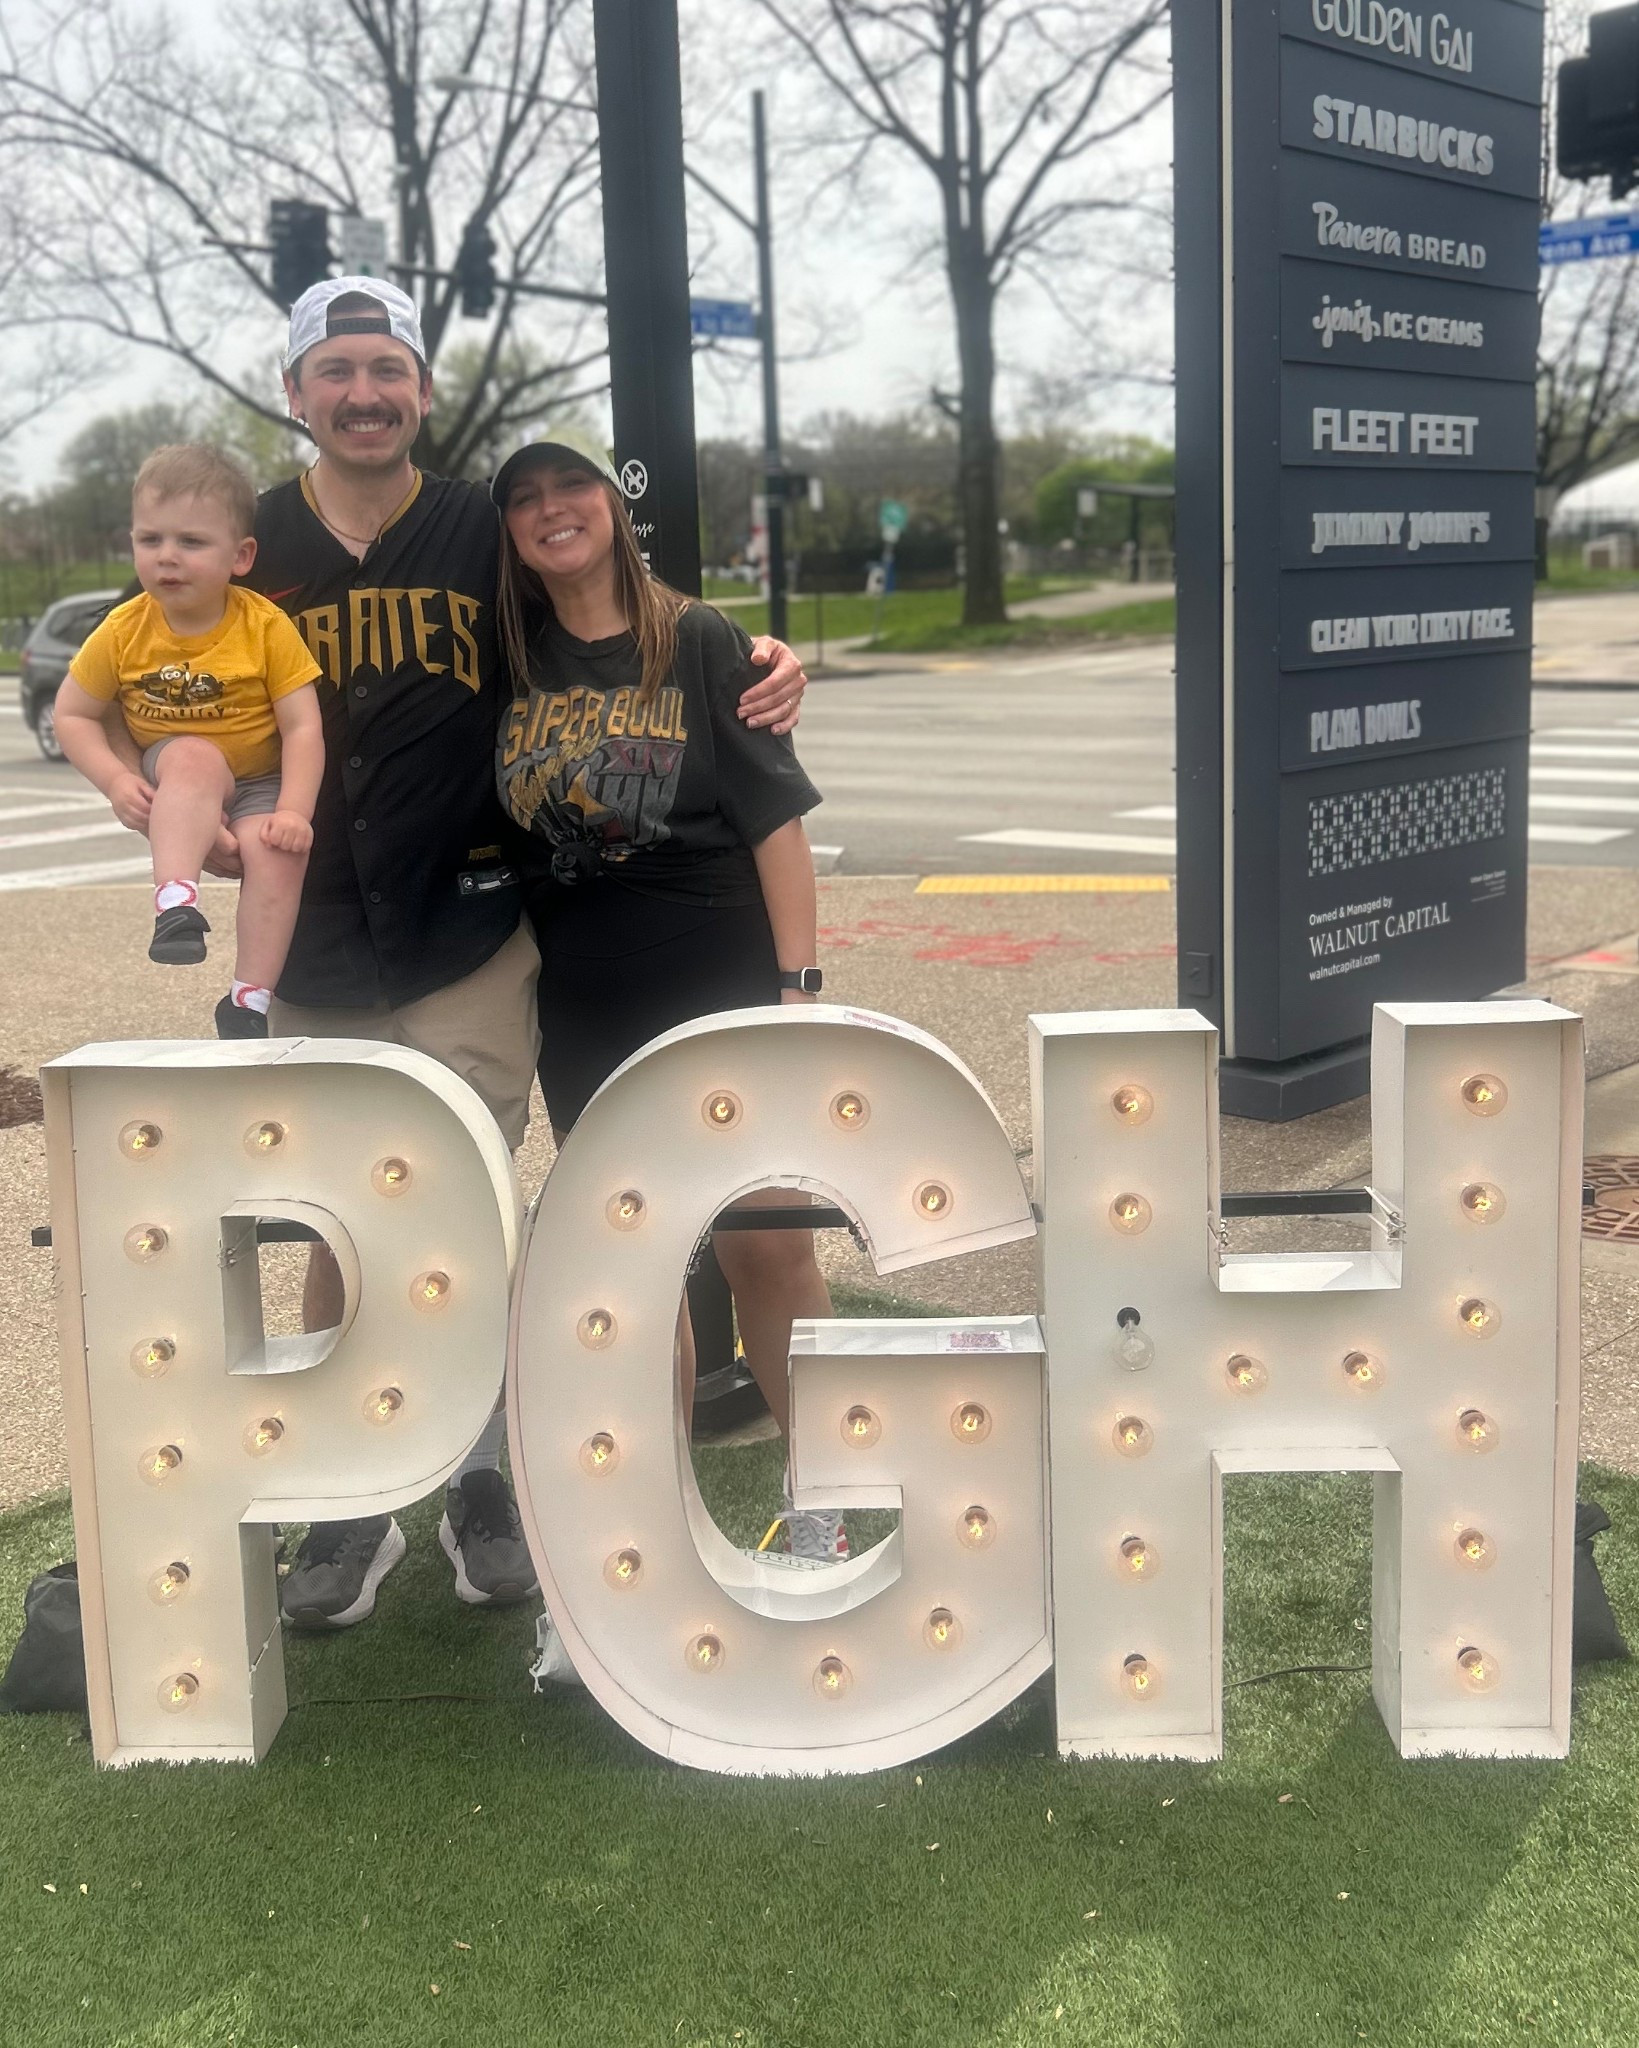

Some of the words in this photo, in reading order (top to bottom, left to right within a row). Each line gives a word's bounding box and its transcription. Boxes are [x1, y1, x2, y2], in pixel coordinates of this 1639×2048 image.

[1429, 13, 1473, 73] GAI
[1312, 94, 1494, 176] STARBUCKS
[1311, 201, 1402, 257] Panera
[1408, 233, 1487, 269] BREAD
[1590, 232, 1632, 257] Ave
[1383, 311, 1414, 340] ICE
[1415, 315, 1484, 348] CREAMS
[1312, 407, 1406, 453] FLEET
[1410, 412, 1480, 456] FEET
[1311, 511, 1405, 554] JIMMY
[1407, 511, 1491, 551] JOHN'S
[291, 586, 484, 696] RATES
[1310, 616, 1370, 653] CLEAN
[1371, 613, 1419, 647] YOUR
[1420, 609, 1472, 644] DIRTY
[606, 686, 689, 743] BOWL
[1310, 706, 1362, 752] PLAYA
[1364, 699, 1422, 745] BOWLS
[1309, 908, 1338, 926] Owned
[1339, 906, 1346, 919] &
[1347, 896, 1382, 917] Managed
[1383, 895, 1393, 909] by
[1309, 919, 1380, 958] WALNUT
[1384, 901, 1451, 939] CAPITAL
[1309, 952, 1381, 981] walnutcapital.com
[41, 999, 1584, 1778] PGH
